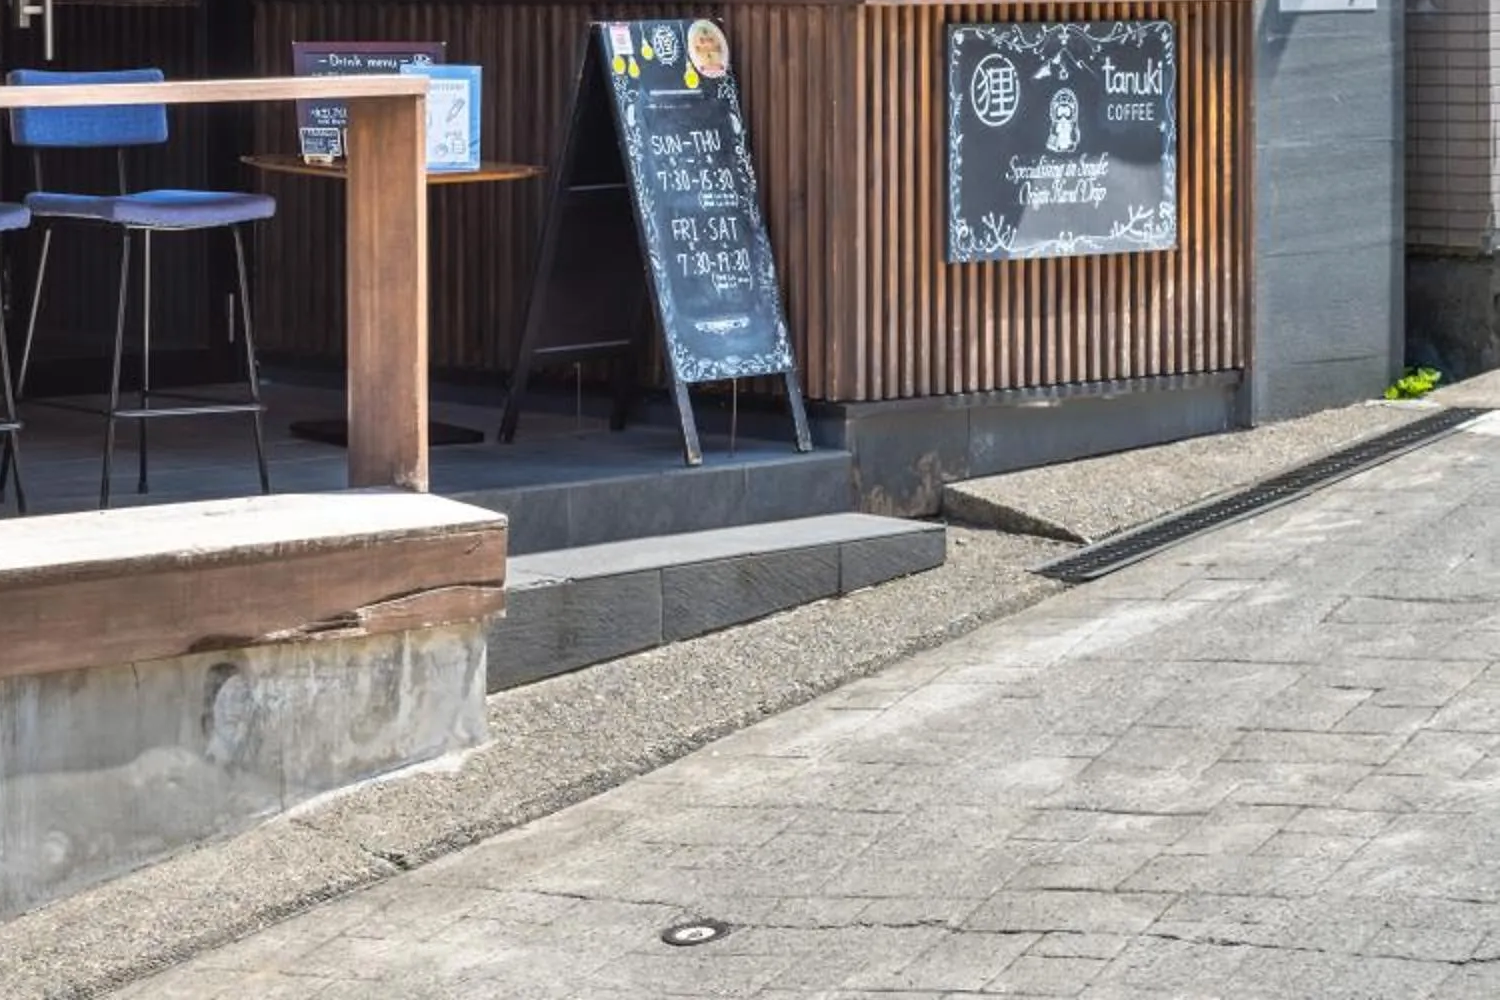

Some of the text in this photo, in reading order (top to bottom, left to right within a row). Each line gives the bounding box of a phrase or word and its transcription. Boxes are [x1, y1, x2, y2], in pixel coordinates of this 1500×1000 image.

[974, 58, 1017, 122] 狸
[1101, 56, 1164, 95] tanuki
[1107, 102, 1156, 121] COFFEE
